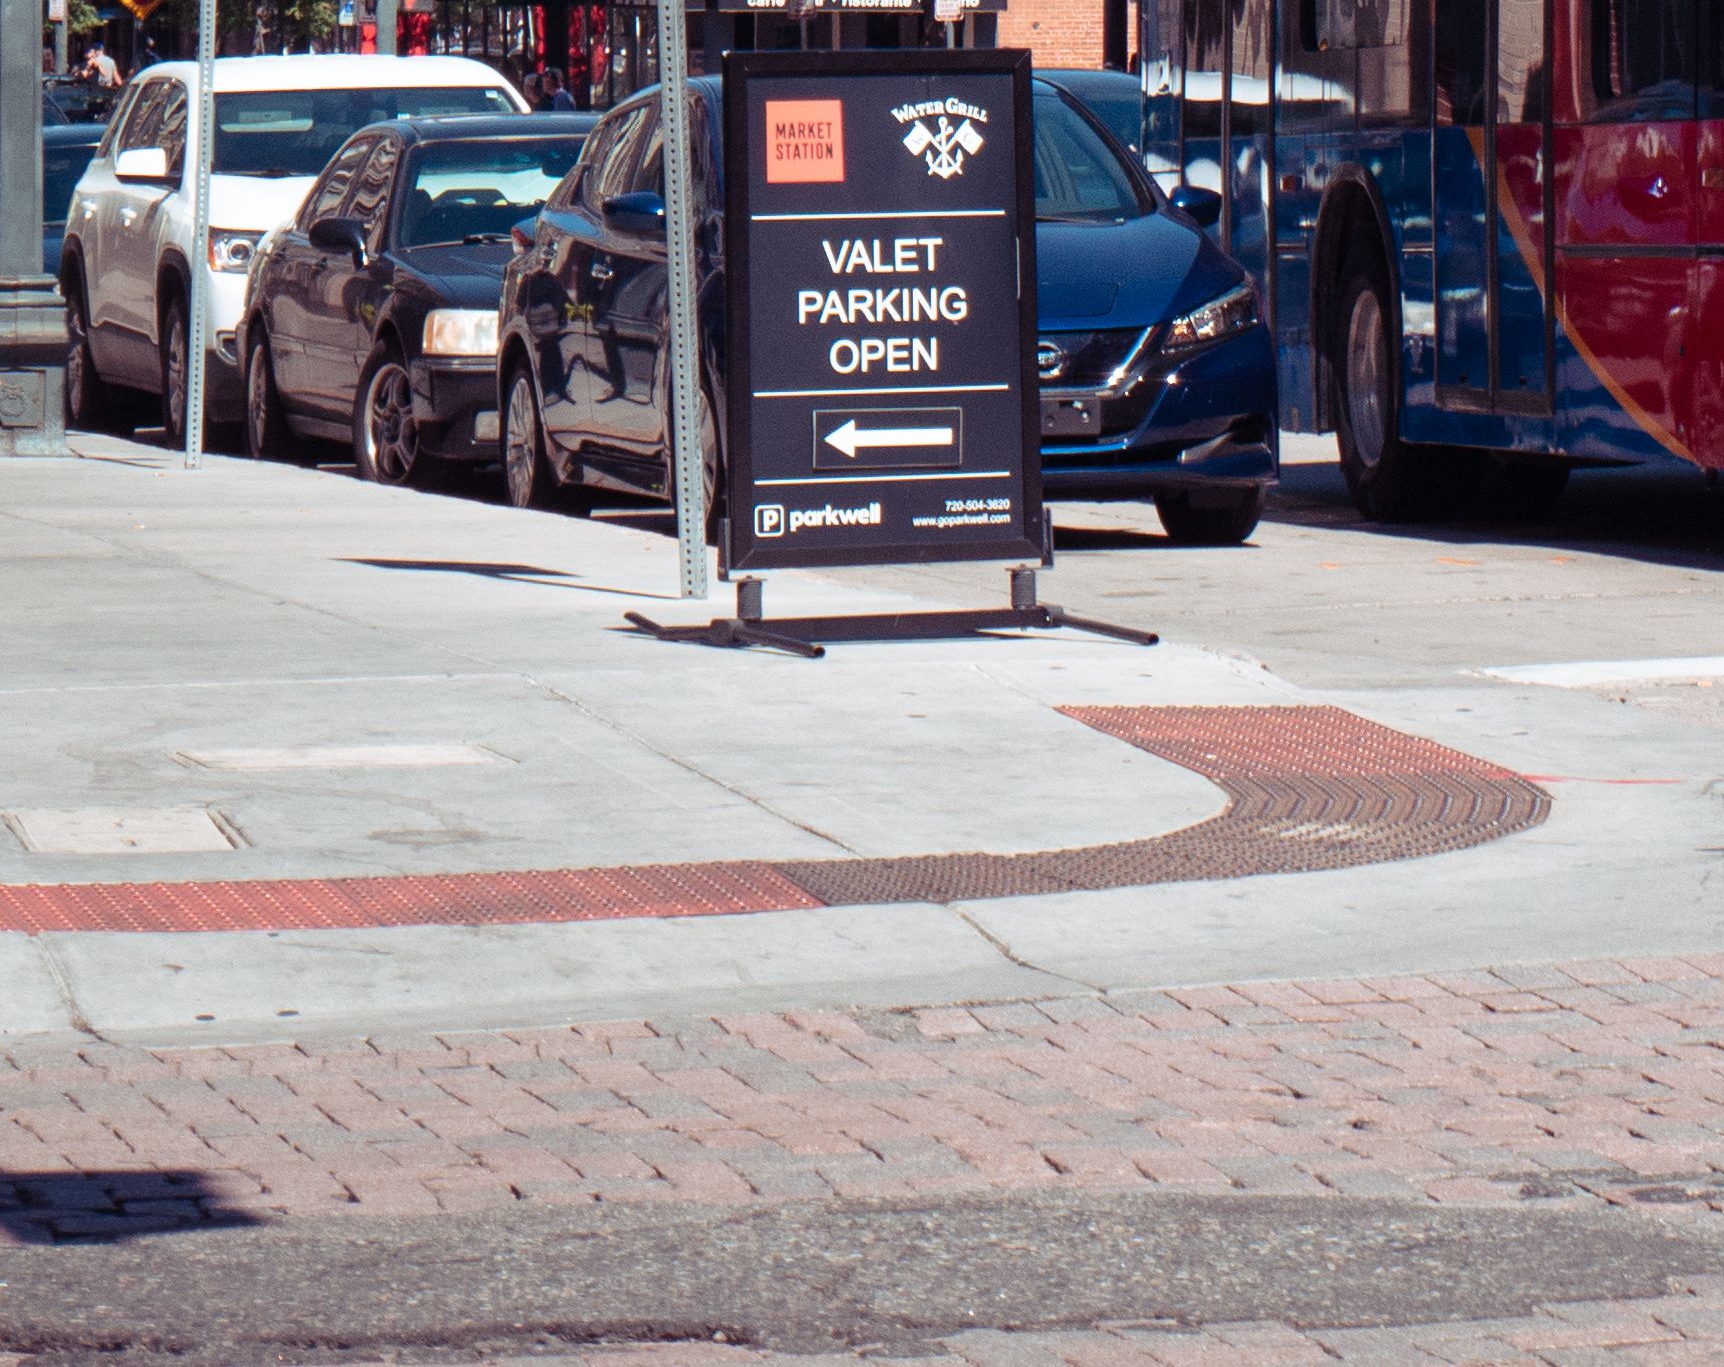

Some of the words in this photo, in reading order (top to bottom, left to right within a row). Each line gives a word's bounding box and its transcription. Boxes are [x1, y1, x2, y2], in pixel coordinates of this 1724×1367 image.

[890, 100, 945, 124] WATER
[945, 97, 988, 123] GRILL
[775, 121, 833, 141] MARKET
[776, 142, 834, 162] STATION
[822, 238, 943, 273] VALET
[798, 287, 968, 324] PARKING
[829, 337, 938, 373] OPEN
[789, 502, 881, 532] parkwell
